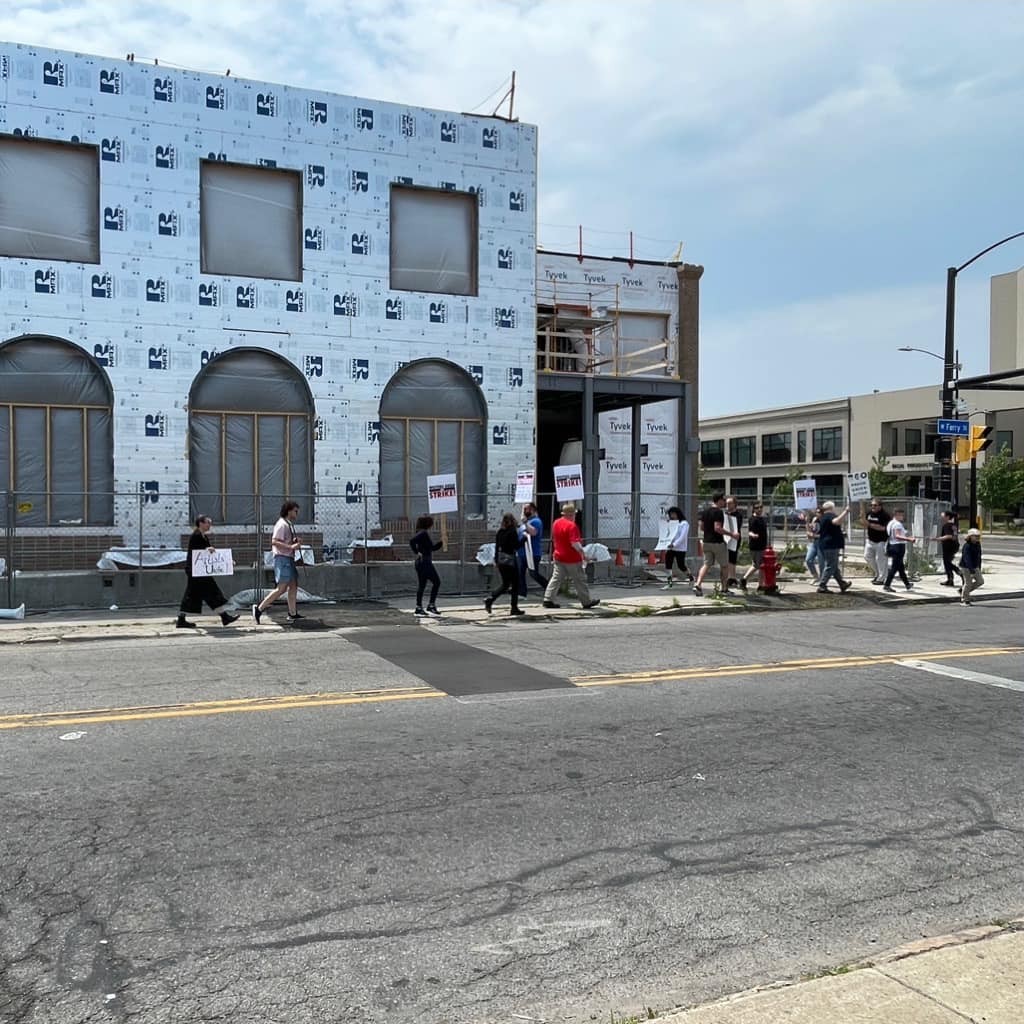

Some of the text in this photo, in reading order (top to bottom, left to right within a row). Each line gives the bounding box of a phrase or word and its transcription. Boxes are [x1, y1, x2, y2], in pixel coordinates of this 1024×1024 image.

[584, 274, 606, 283] Tyvek
[622, 277, 643, 287] Tyvek
[610, 422, 631, 431] Tyvek
[646, 423, 667, 432] Tyvek
[606, 461, 627, 470] Tyvek
[643, 462, 663, 471] Tyvek
[556, 479, 582, 488] STRIKE!
[429, 490, 456, 499] STRIKE!
